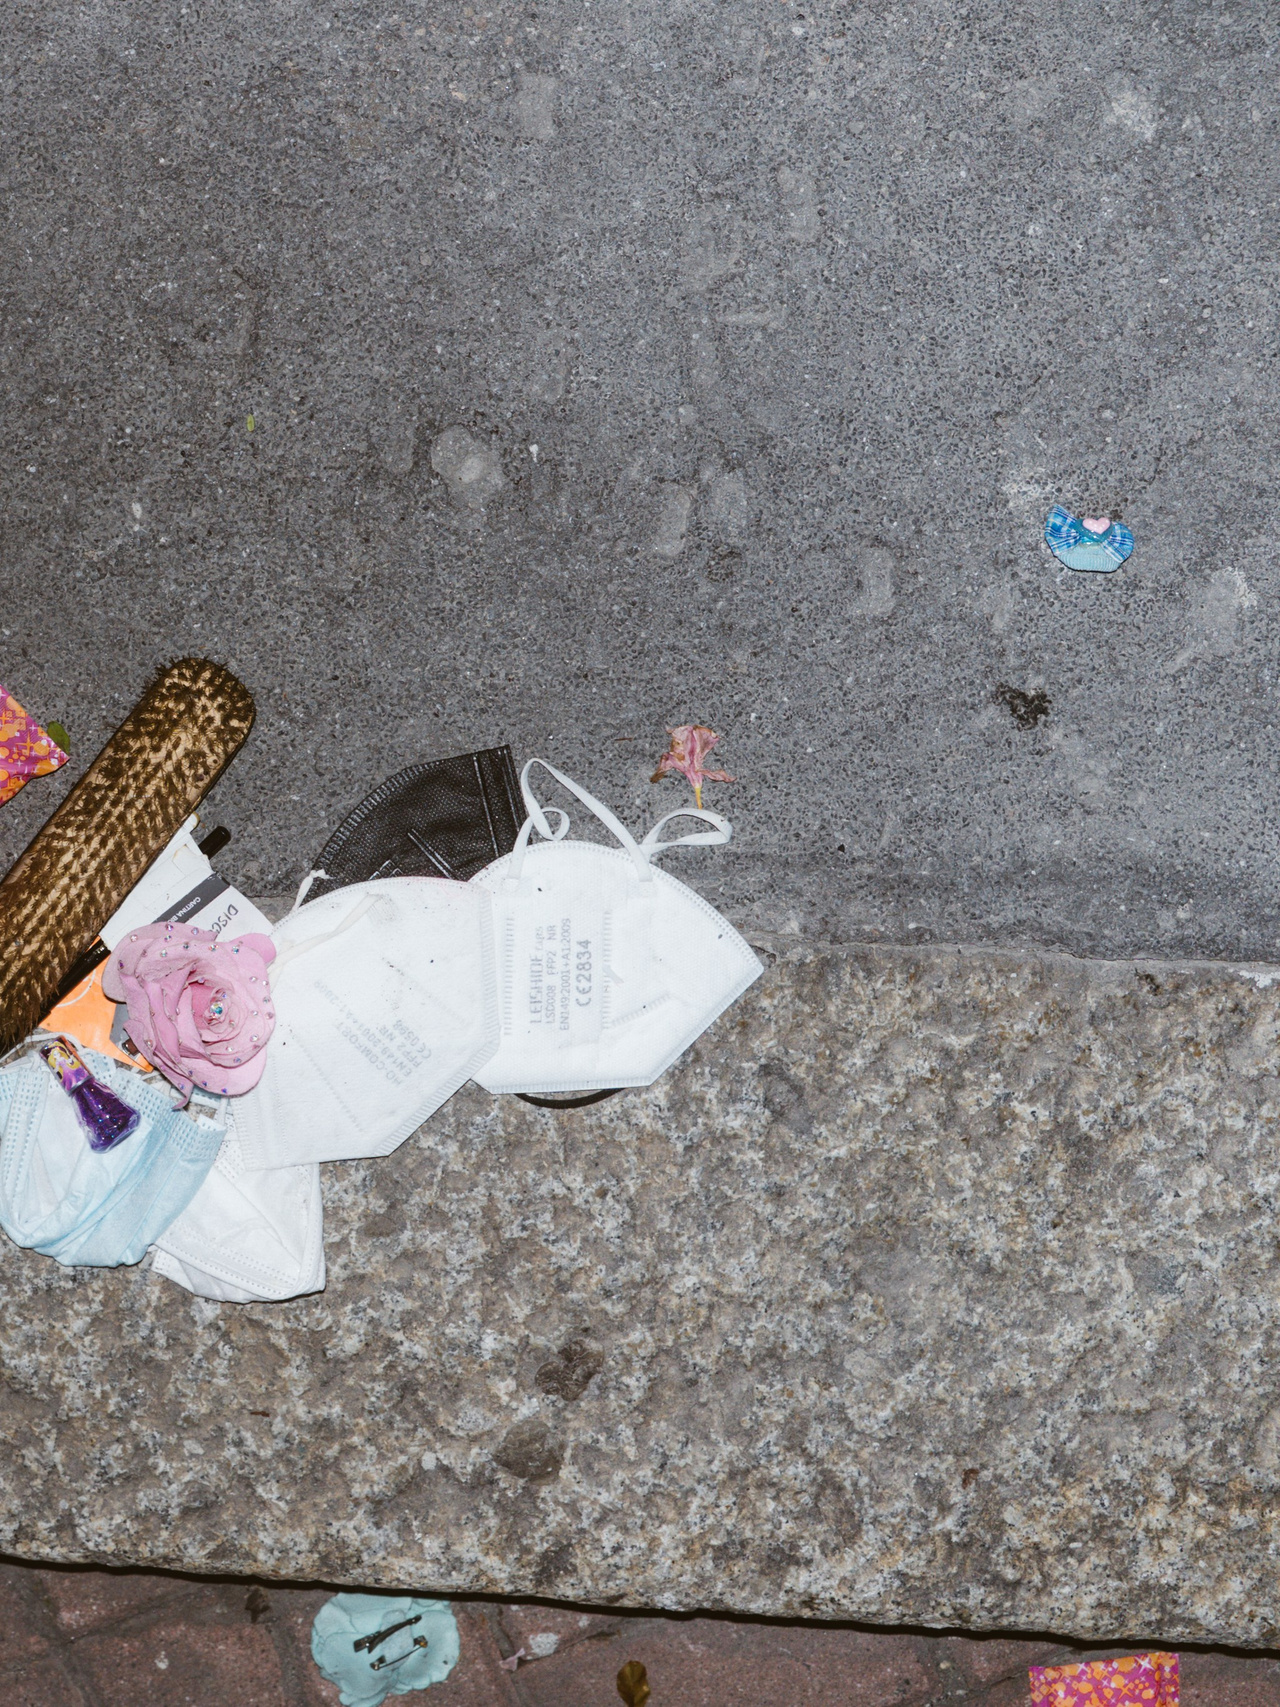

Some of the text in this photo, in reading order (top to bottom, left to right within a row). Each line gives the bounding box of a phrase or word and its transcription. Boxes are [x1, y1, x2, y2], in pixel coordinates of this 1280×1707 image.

[175, 896, 202, 918] CARTINA
[546, 925, 556, 940] NR
[546, 951, 556, 975] FFP2
